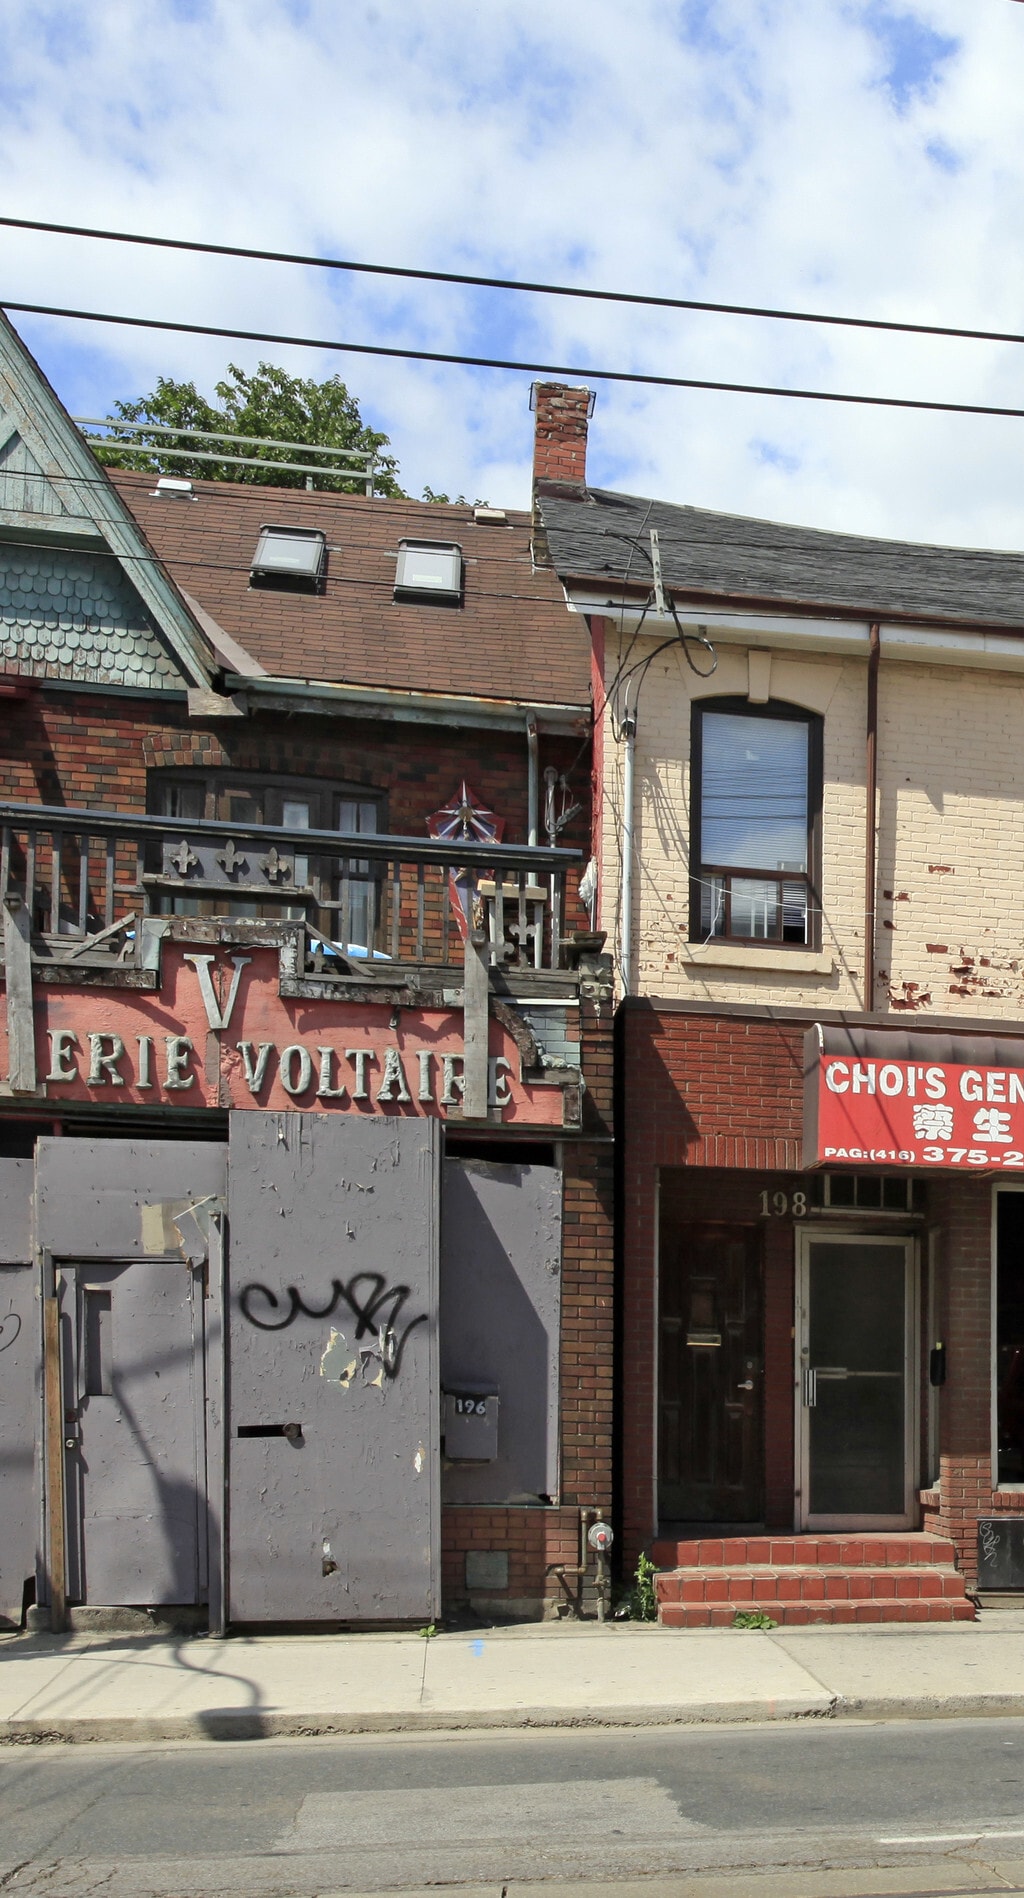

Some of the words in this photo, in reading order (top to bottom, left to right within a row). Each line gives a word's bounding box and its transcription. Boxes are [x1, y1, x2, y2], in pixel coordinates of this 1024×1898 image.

[183, 953, 252, 1029] V
[5, 1029, 195, 1090] ERIE
[825, 1061, 947, 1099] CHOI'S
[824, 1147, 916, 1163] PAG:(416)
[759, 1190, 807, 1217] 198
[457, 1399, 486, 1415] 196
